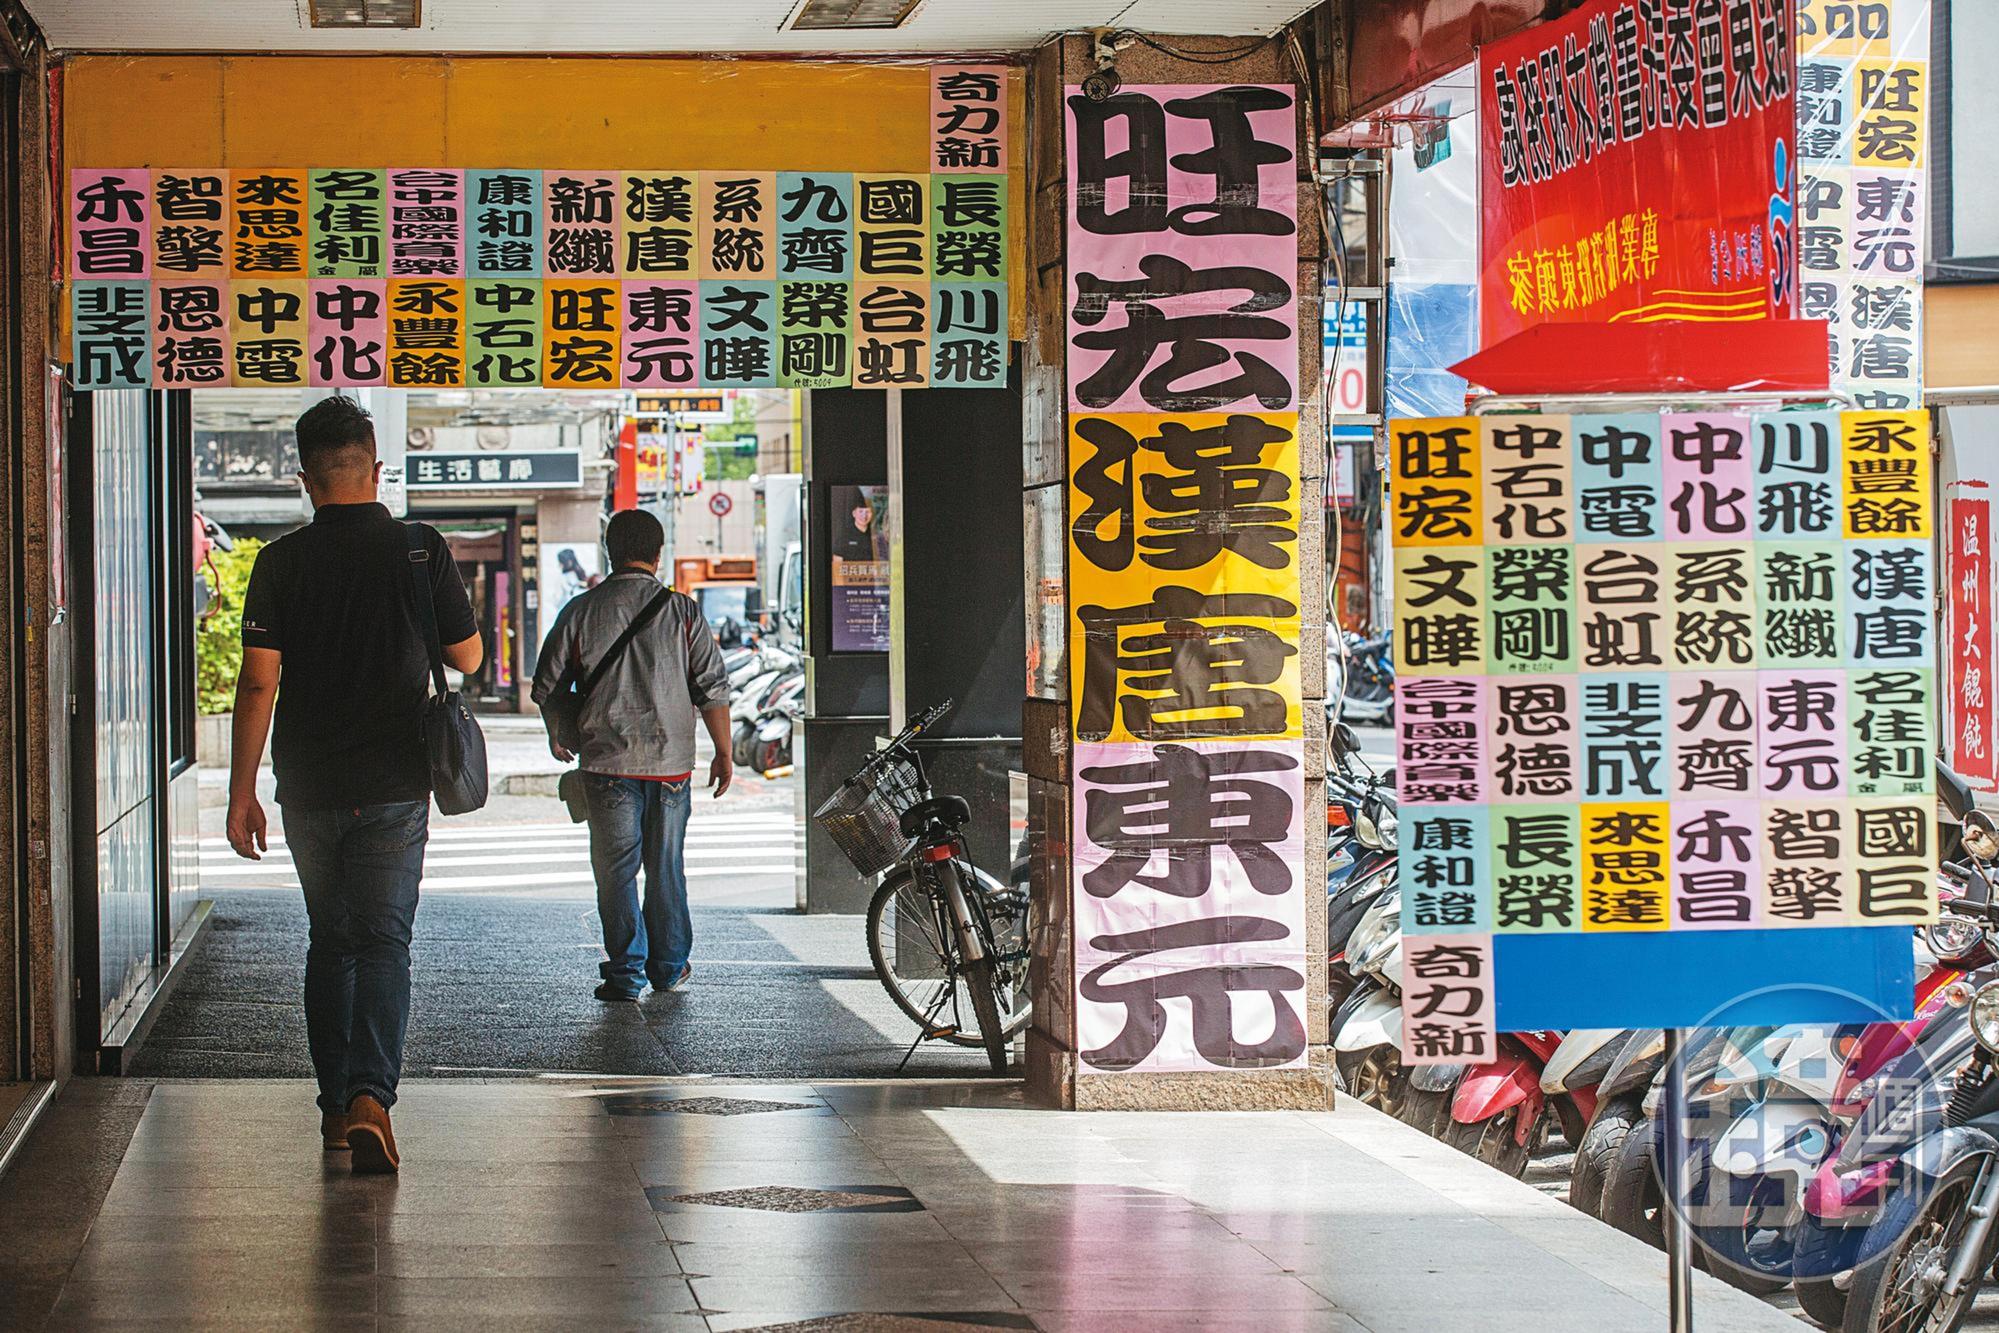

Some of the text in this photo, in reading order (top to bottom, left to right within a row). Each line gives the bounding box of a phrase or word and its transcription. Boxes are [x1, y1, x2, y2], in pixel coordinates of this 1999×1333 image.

[936, 72, 1001, 167] 奇力新
[1859, 68, 1919, 161] 旺宏
[156, 175, 223, 272] 智擎
[235, 175, 302, 271] 來思達
[313, 171, 381, 264] 名佳利
[477, 175, 533, 271] 康和證
[549, 178, 615, 273] 新纖
[626, 177, 692, 271] 漢唐
[712, 179, 763, 272] 系統
[782, 177, 847, 273] 九齊
[859, 180, 924, 274] 國巨
[936, 182, 1002, 277] 長榮
[1067, 86, 1295, 411] 旺宏
[1854, 177, 1916, 273] 東元
[77, 287, 146, 384] 斐成
[157, 286, 224, 382] 恩德
[236, 288, 302, 382] 中電
[314, 285, 381, 381] 中化
[391, 283, 460, 384] 永豐餘
[472, 284, 535, 383] 中石化
[551, 288, 614, 381] 旺宏
[627, 287, 693, 382] 東元
[705, 286, 770, 381] 文曄
[782, 282, 848, 377] 榮剛
[858, 286, 925, 384] 台虹
[935, 289, 1000, 382] 川飛
[1851, 284, 1913, 378] 漢唐
[1398, 428, 1472, 538] 旺宏
[1492, 425, 1566, 538] 中石化
[1580, 426, 1655, 537] 中電
[1671, 423, 1745, 533] 中化
[1759, 423, 1833, 533] 川飛
[1848, 420, 1920, 532] 永豐餘
[1072, 415, 1298, 741] 漢唐
[1403, 555, 1480, 666] 文曄
[1493, 548, 1569, 660] 榮剛
[1584, 551, 1662, 666] 台虹
[1675, 549, 1752, 664] 系統
[1765, 552, 1836, 657] 新纖
[1853, 548, 1926, 658] 漢唐
[1496, 685, 1572, 795] 恩德
[1586, 683, 1661, 795] 斐成
[1678, 680, 1752, 791] 九齊
[1766, 680, 1838, 790] 東元
[1854, 673, 1925, 778] 名佳利
[1079, 744, 1307, 1071] 東元
[1413, 818, 1475, 925] 康和證
[1498, 815, 1573, 927] 長榮
[1590, 813, 1663, 923] 來思達
[1769, 809, 1841, 919] 智擎
[1857, 807, 1928, 917] 國巨
[1412, 946, 1485, 1056] 奇力新
